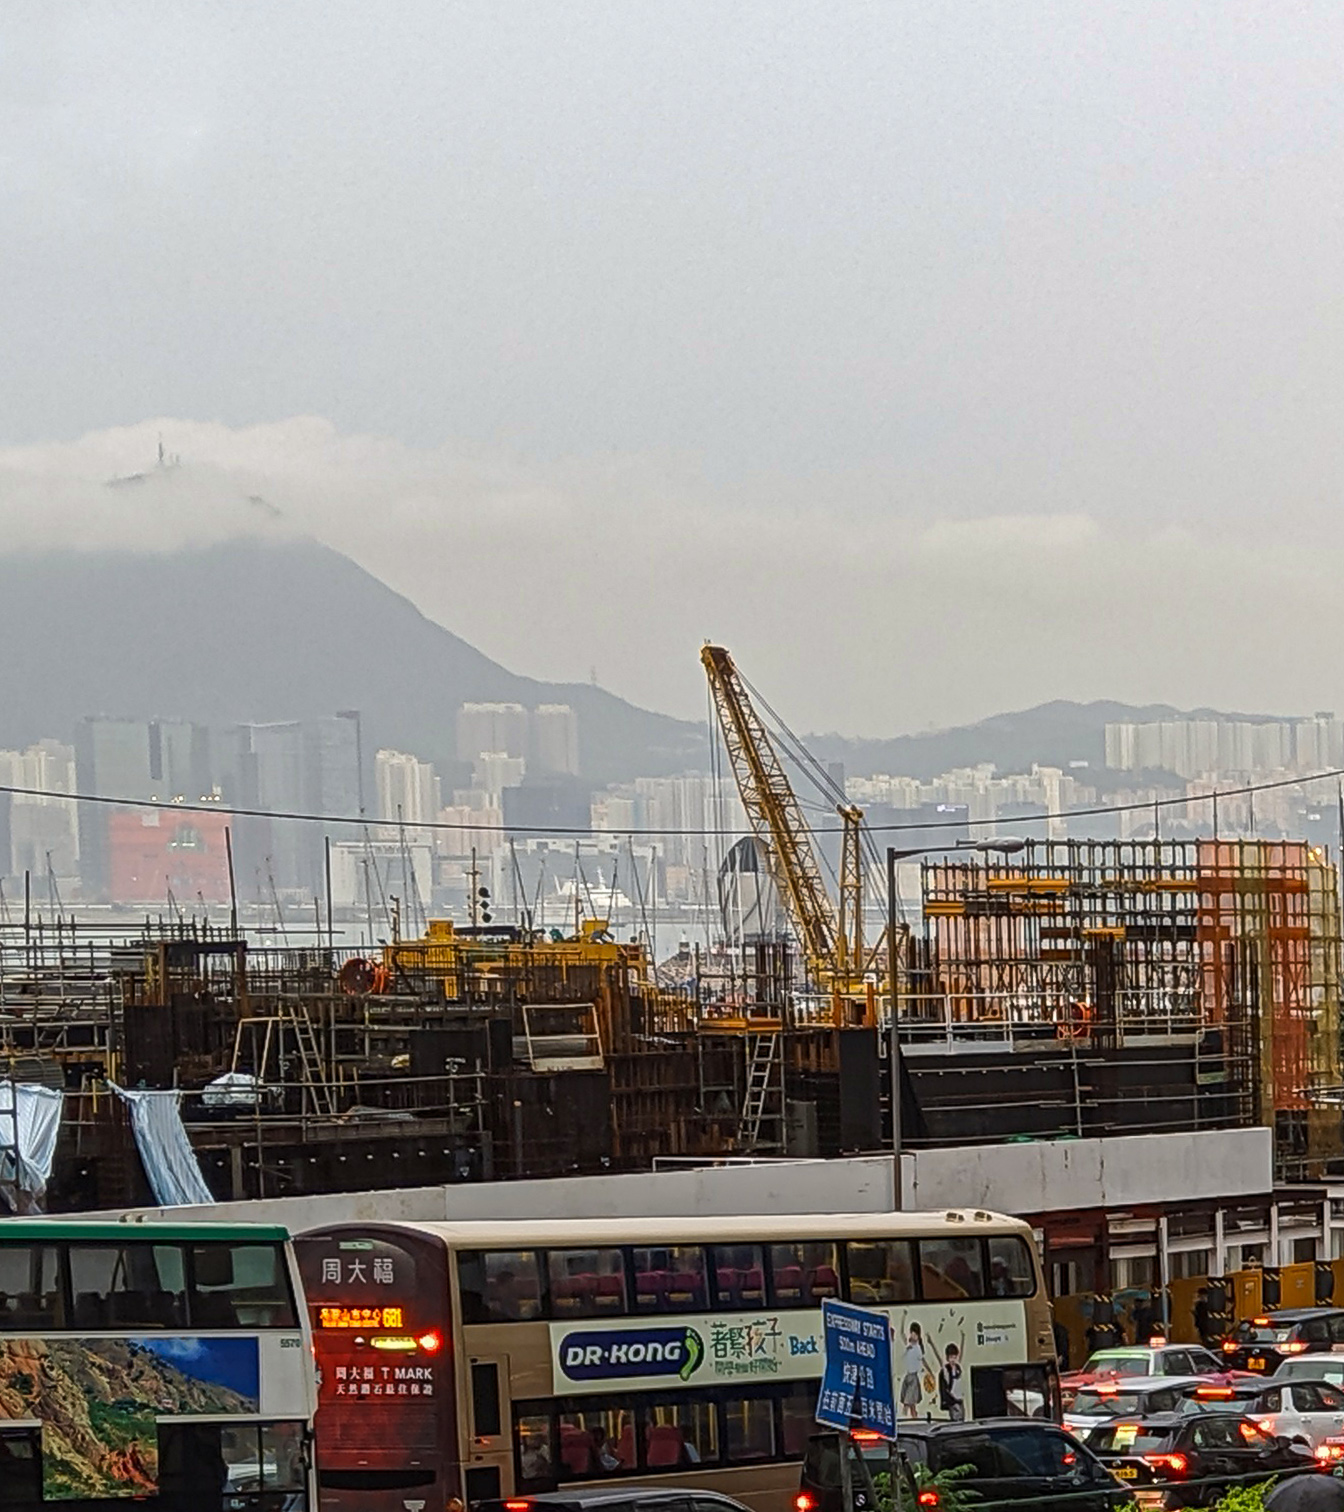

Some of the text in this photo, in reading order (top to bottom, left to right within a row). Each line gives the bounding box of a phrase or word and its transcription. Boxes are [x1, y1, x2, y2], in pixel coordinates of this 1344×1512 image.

[322, 1258, 394, 1285] 周大福
[382, 1307, 403, 1328] 681
[827, 1312, 885, 1341] EXPRESSWAY STARTS
[790, 1336, 819, 1355] Back
[839, 1336, 876, 1359] 500m AHEAD
[336, 1366, 374, 1380] 周大福
[381, 1366, 433, 1380] T MARK
